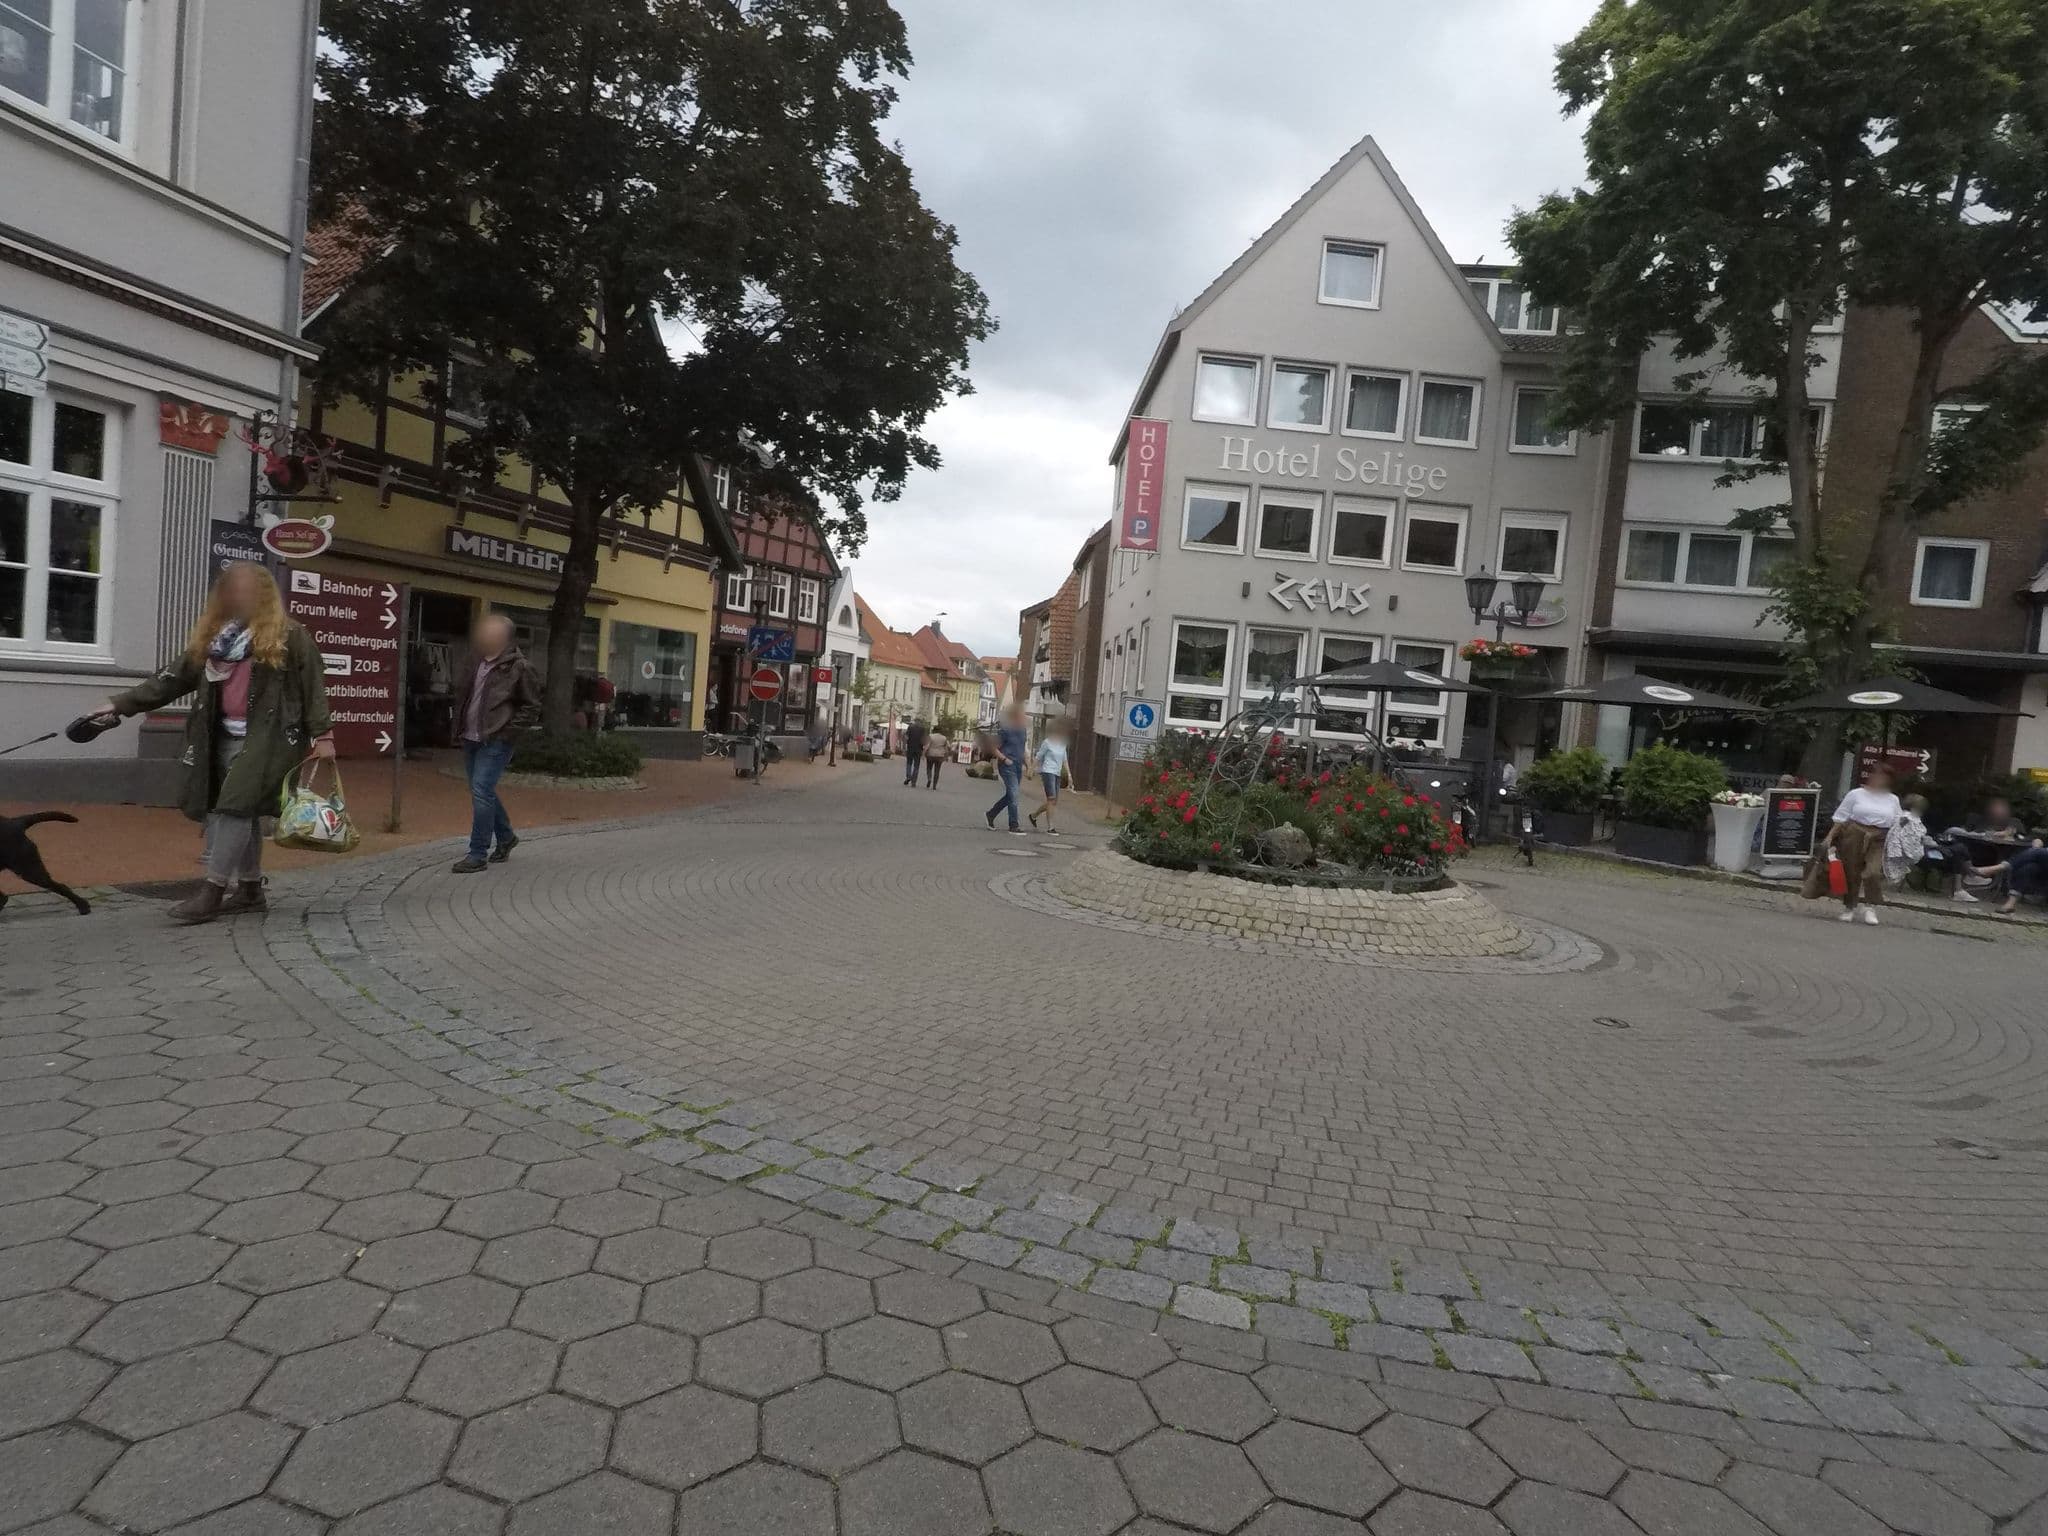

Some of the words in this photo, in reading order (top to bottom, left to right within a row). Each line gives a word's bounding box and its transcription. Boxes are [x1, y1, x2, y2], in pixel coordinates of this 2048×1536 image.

[1138, 426, 1156, 514] HOTEL
[1217, 436, 1320, 479] Hotel
[1334, 447, 1448, 498] Selige
[1135, 520, 1147, 534] P
[322, 579, 374, 598] Bahnhof
[1268, 571, 1371, 615] ZEUS
[290, 600, 326, 617] Forum
[329, 605, 358, 620] Melle
[719, 624, 748, 636] odafone
[315, 630, 398, 651] Grönenbergpark
[354, 659, 381, 673] ZOB
[324, 684, 389, 699] adtbibliothek
[330, 710, 395, 723] desturnschule
